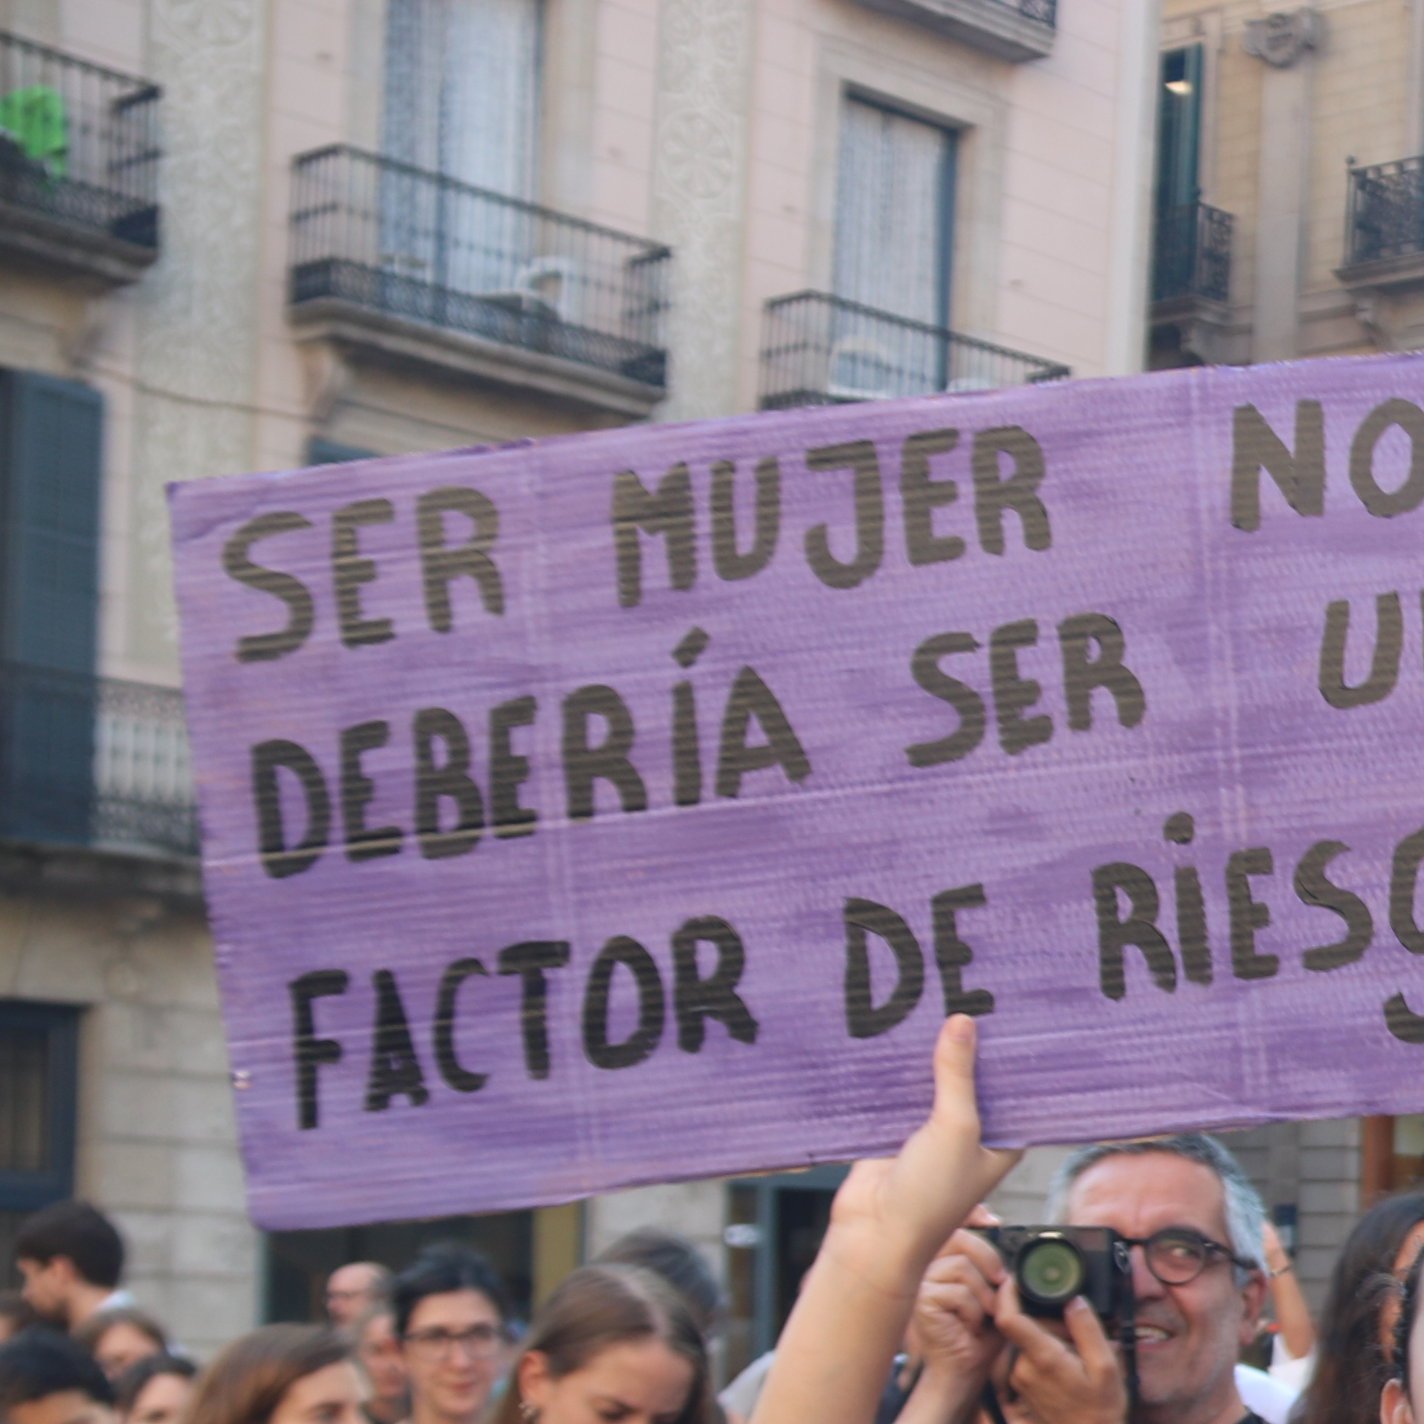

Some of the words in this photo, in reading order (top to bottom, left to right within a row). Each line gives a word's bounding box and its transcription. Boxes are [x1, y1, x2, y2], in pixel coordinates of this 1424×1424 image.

[220, 485, 506, 663] SER
[610, 425, 1054, 608] MUJER
[250, 627, 812, 879] DEBERÍA
[905, 611, 1147, 768] SER
[287, 915, 760, 1130] FACTOR
[843, 884, 996, 1038] DE
